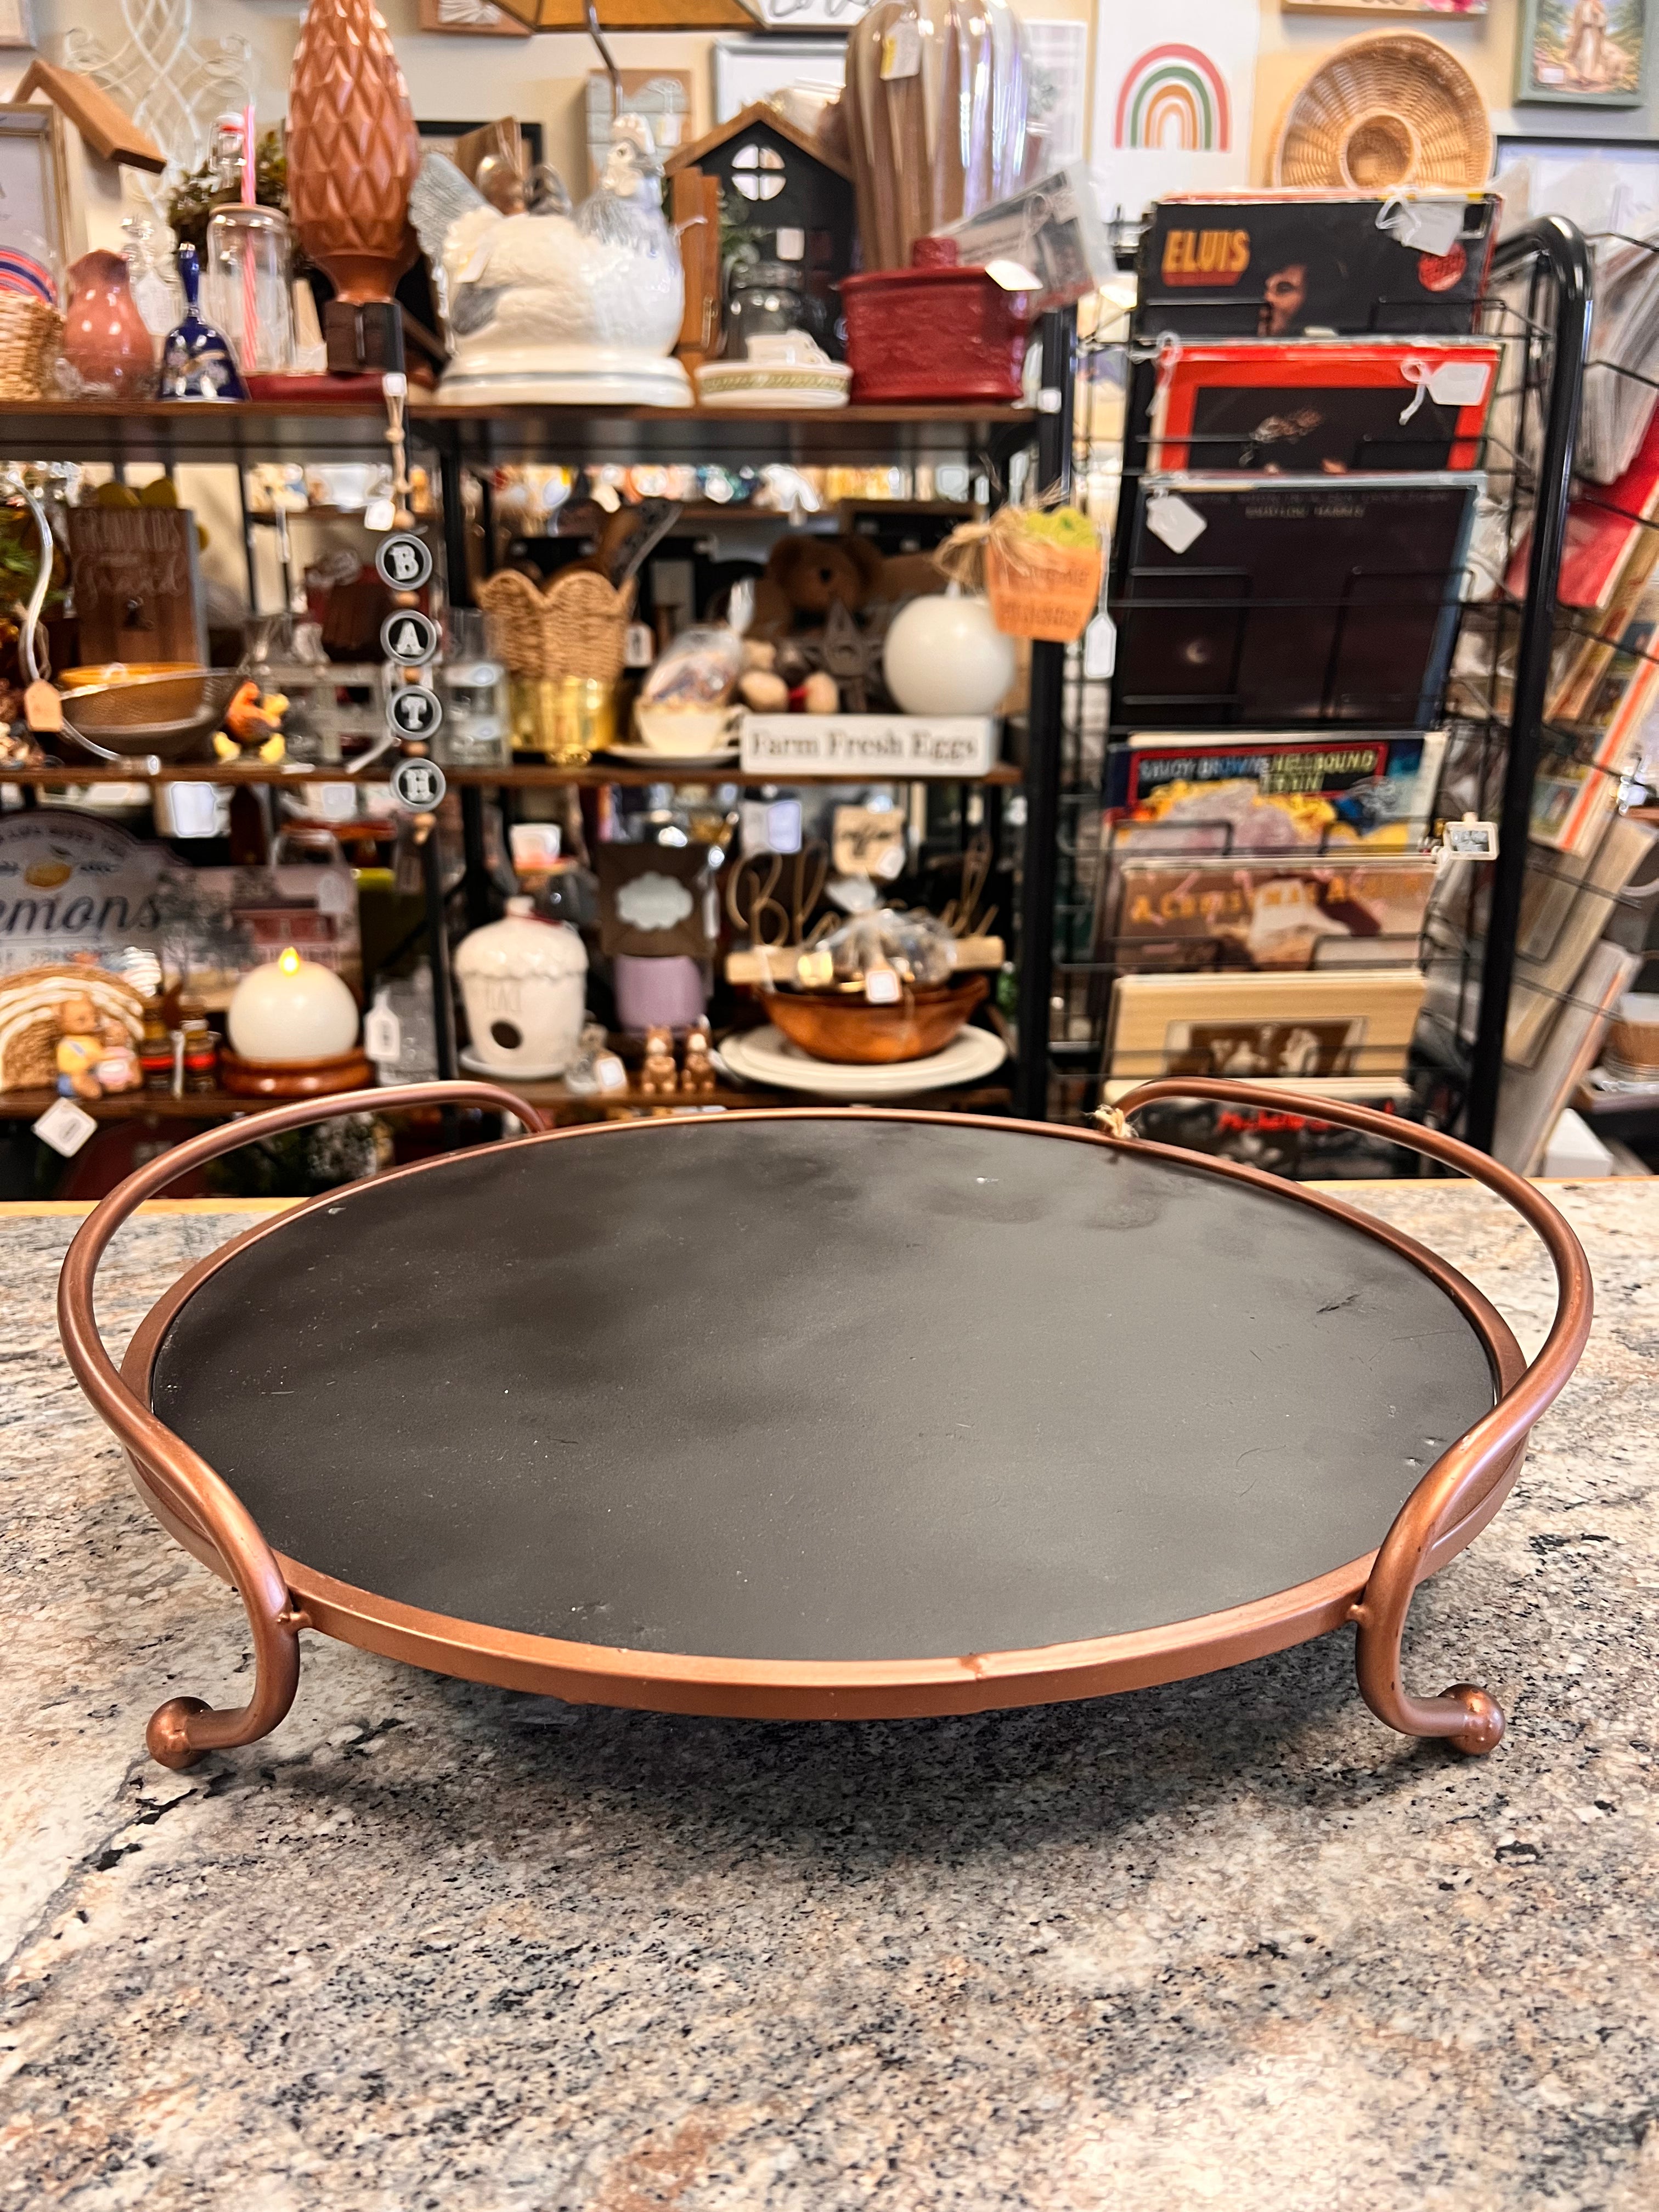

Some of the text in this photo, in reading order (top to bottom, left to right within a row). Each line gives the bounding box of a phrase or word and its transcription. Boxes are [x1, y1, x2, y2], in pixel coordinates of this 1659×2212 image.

[386, 543, 435, 802] BATH
[752, 729, 978, 763] Farm Fresh Eggs
